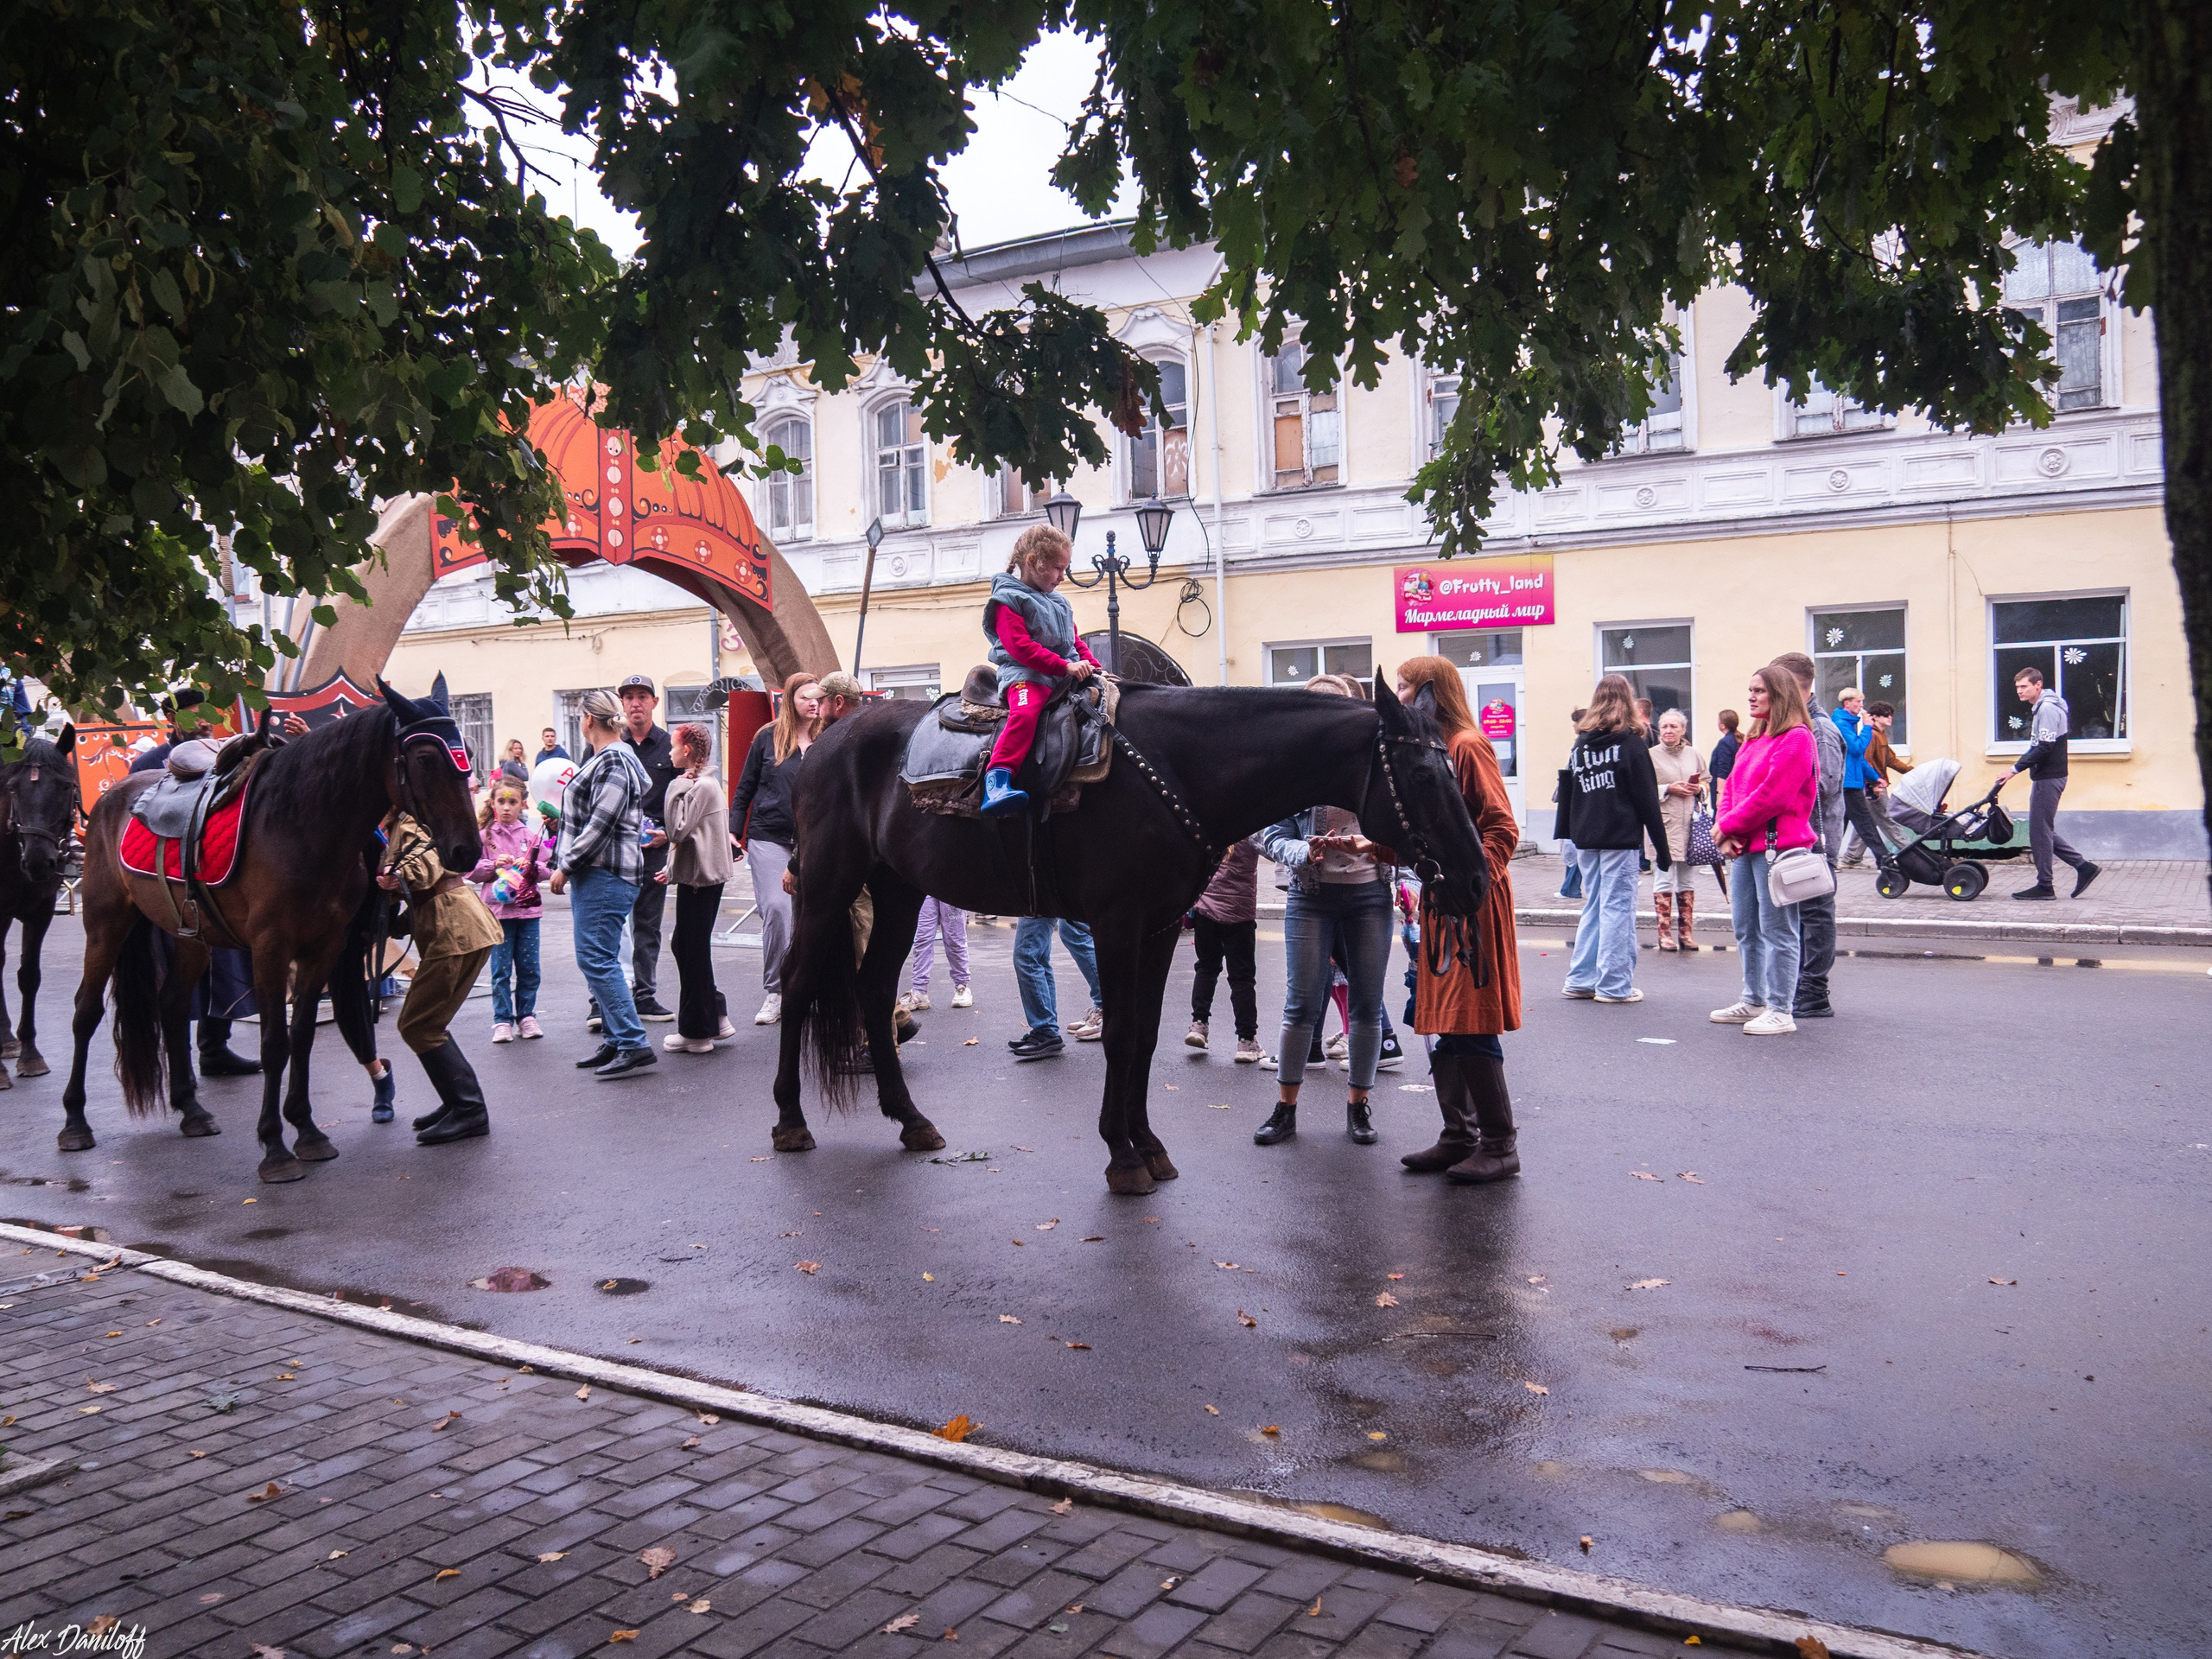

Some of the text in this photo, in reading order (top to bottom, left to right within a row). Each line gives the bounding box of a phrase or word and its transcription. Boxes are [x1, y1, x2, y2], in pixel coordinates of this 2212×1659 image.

[1440, 573, 1544, 595] @Frutty_land
[1404, 603, 1545, 626] Мармеладный мир
[1570, 744, 1621, 776] Lion
[1578, 770, 1616, 793] king
